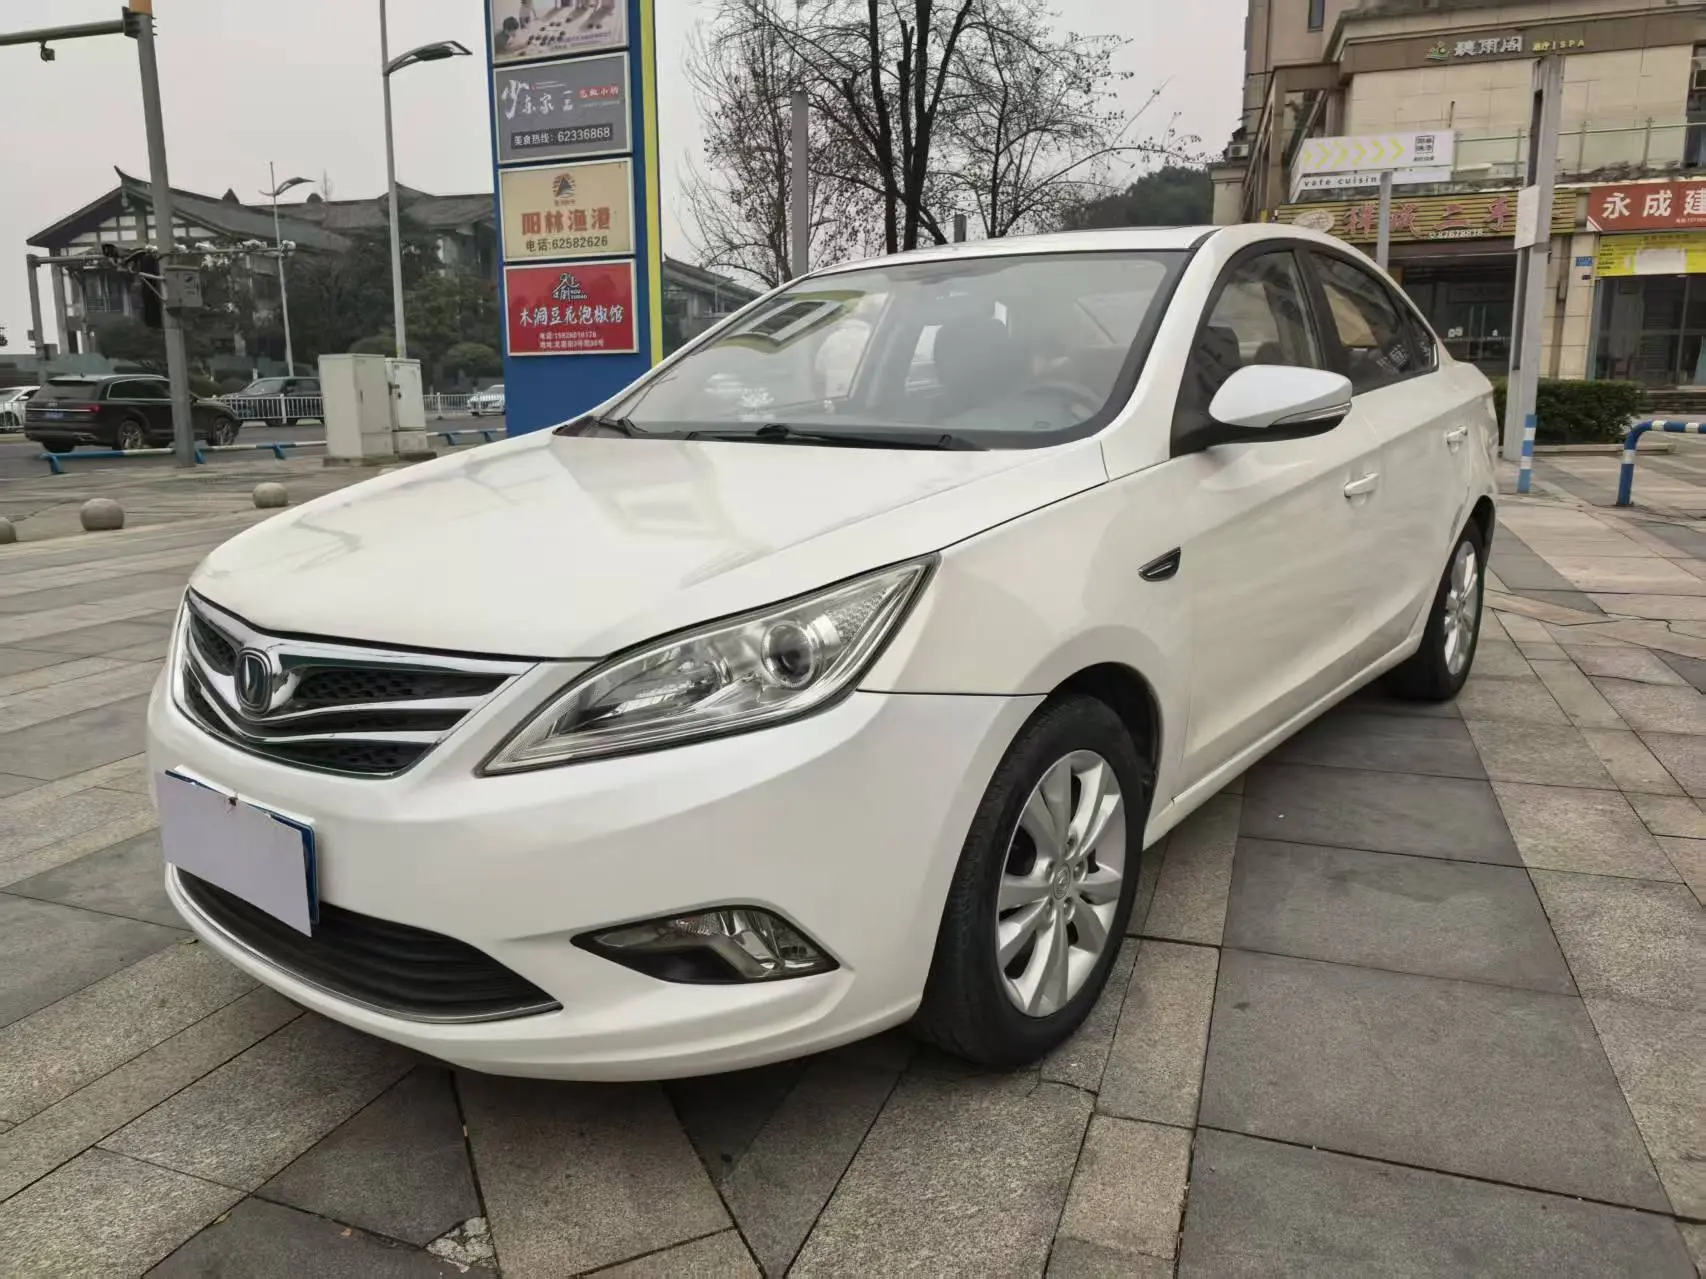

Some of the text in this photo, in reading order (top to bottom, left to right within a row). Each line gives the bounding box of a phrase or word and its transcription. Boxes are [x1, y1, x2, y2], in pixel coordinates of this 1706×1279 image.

[1559, 39, 1585, 49] SPA
[1601, 185, 1706, 218] 永成建
[519, 304, 625, 327] 木洞豆花泡椒馆
